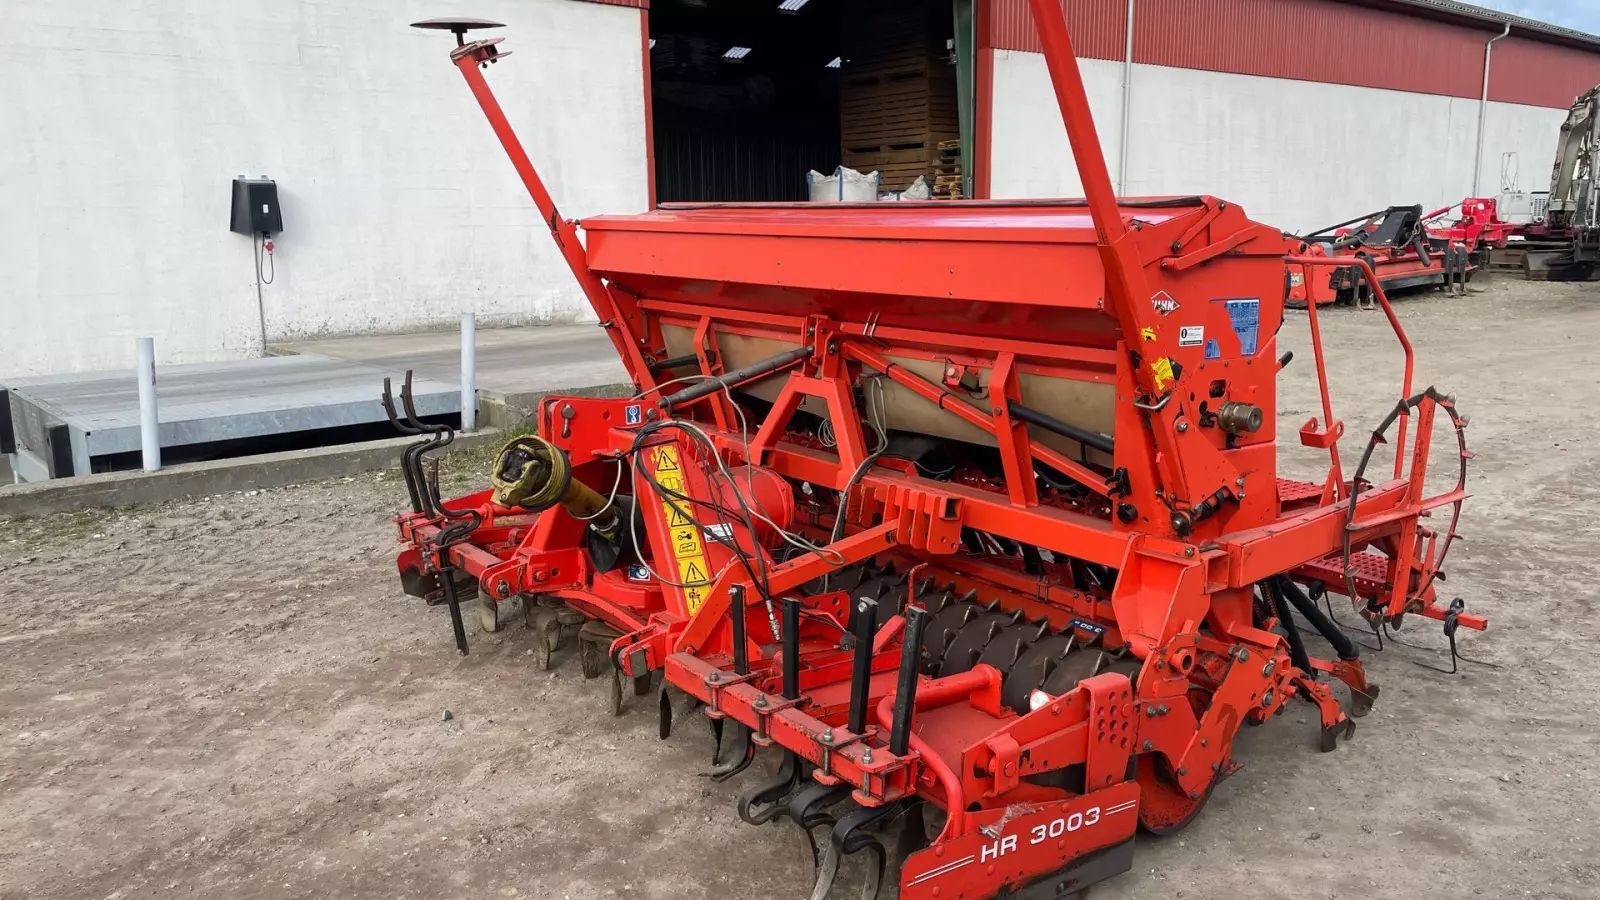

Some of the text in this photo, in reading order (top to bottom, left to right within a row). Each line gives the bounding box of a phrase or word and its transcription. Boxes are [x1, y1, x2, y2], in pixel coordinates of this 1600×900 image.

[1151, 299, 1174, 311] UHN
[980, 806, 1101, 863] HR 3003
